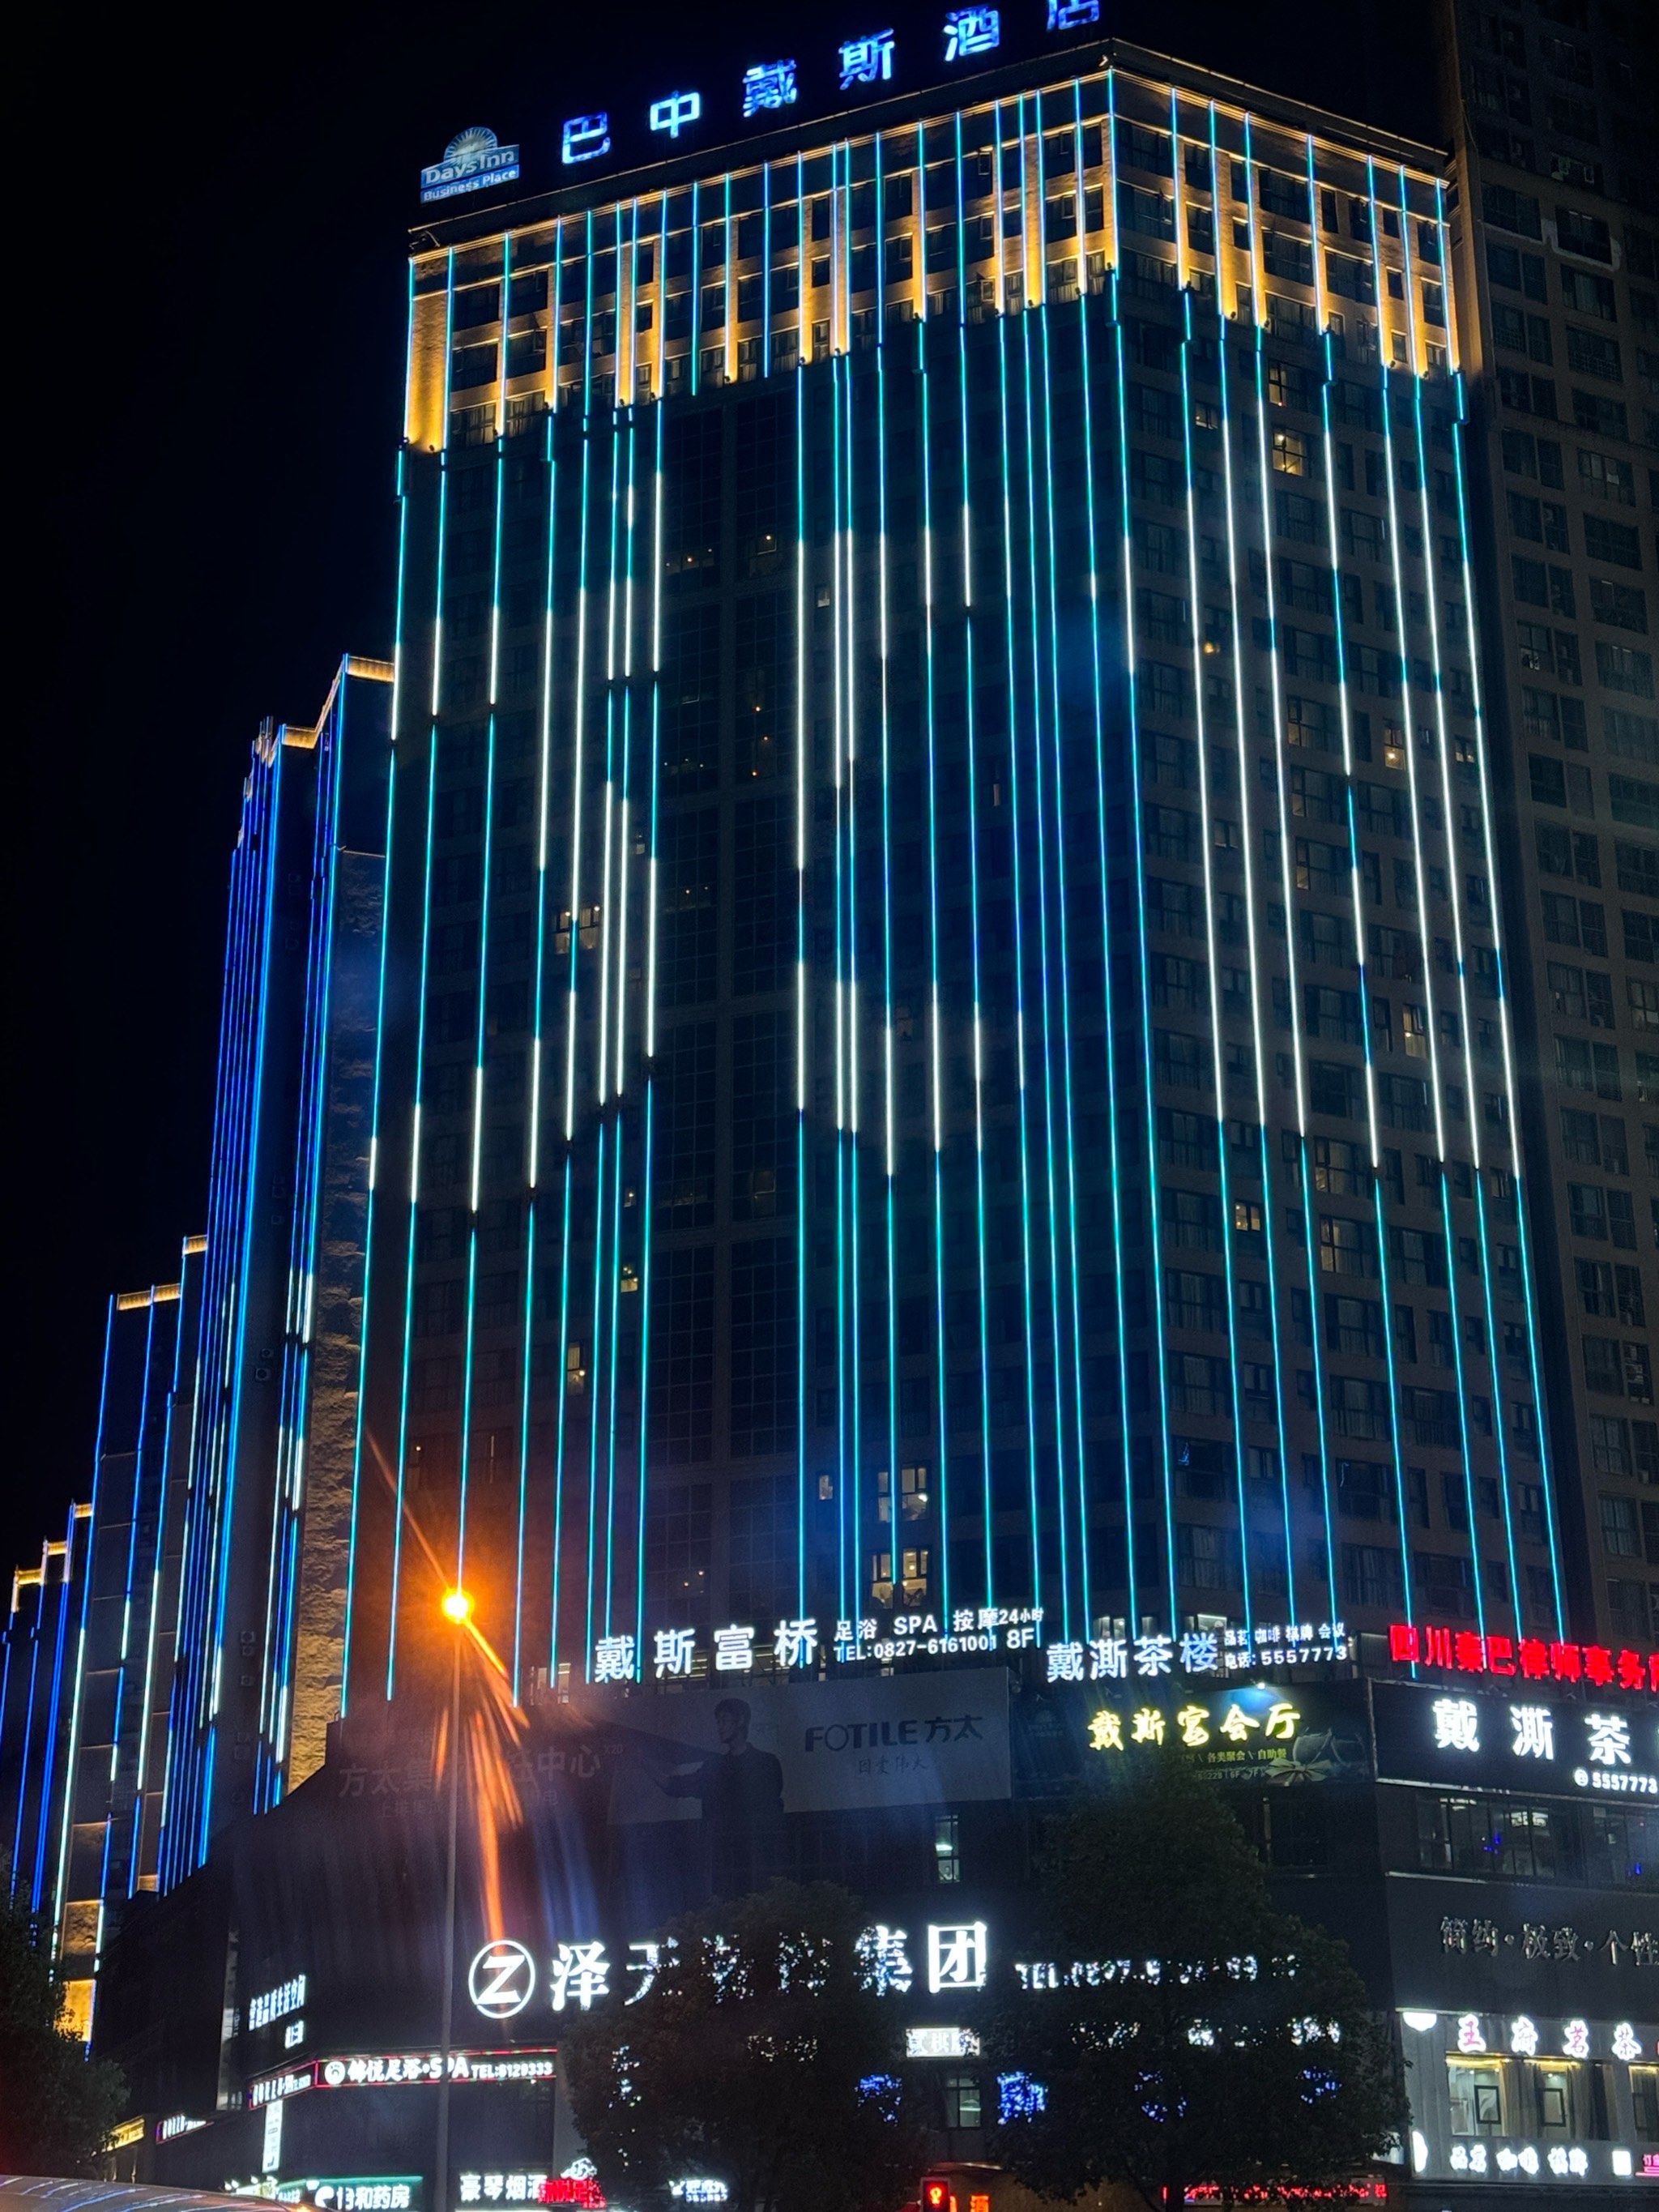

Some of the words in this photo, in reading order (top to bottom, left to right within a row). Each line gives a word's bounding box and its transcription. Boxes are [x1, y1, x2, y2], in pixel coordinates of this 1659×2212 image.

[423, 178, 480, 202] Business
[482, 169, 517, 187] Place
[893, 1614, 938, 1635] SPA
[1006, 1628, 1034, 1649] 8F
[594, 1618, 818, 1683] 戴斯富桥
[804, 1719, 919, 1753] FOTILE
[924, 1714, 984, 1744] 方太
[1432, 1698, 1659, 1766] 戴澌茶
[1457, 2013, 1643, 2061] 王府茗茶
